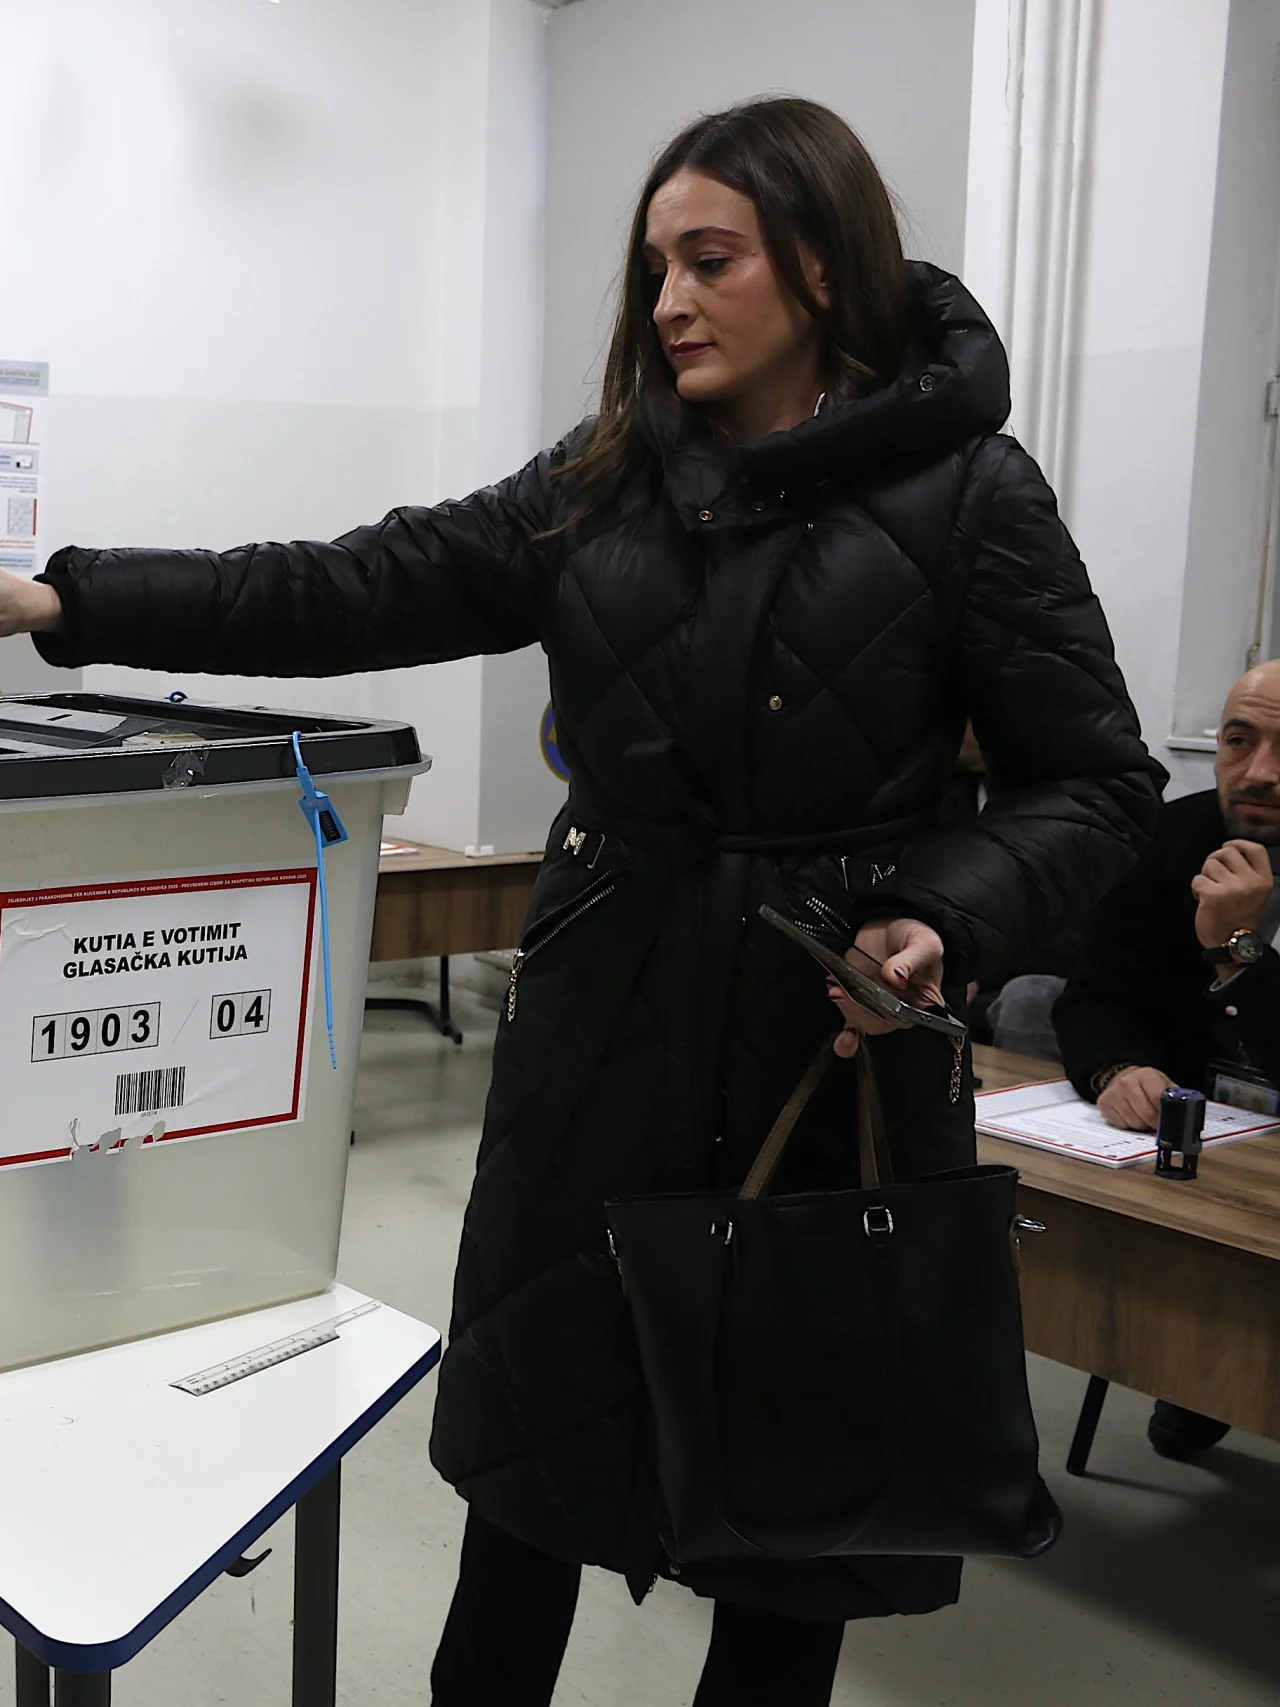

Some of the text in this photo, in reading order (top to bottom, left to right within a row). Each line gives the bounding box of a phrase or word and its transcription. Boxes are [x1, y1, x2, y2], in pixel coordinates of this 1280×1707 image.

[73, 922, 241, 954] KUTIA E VOTIMIT
[63, 944, 248, 979] GLASAČKA KUTIJA
[41, 1009, 151, 1055] 1903
[217, 995, 264, 1033] 04
